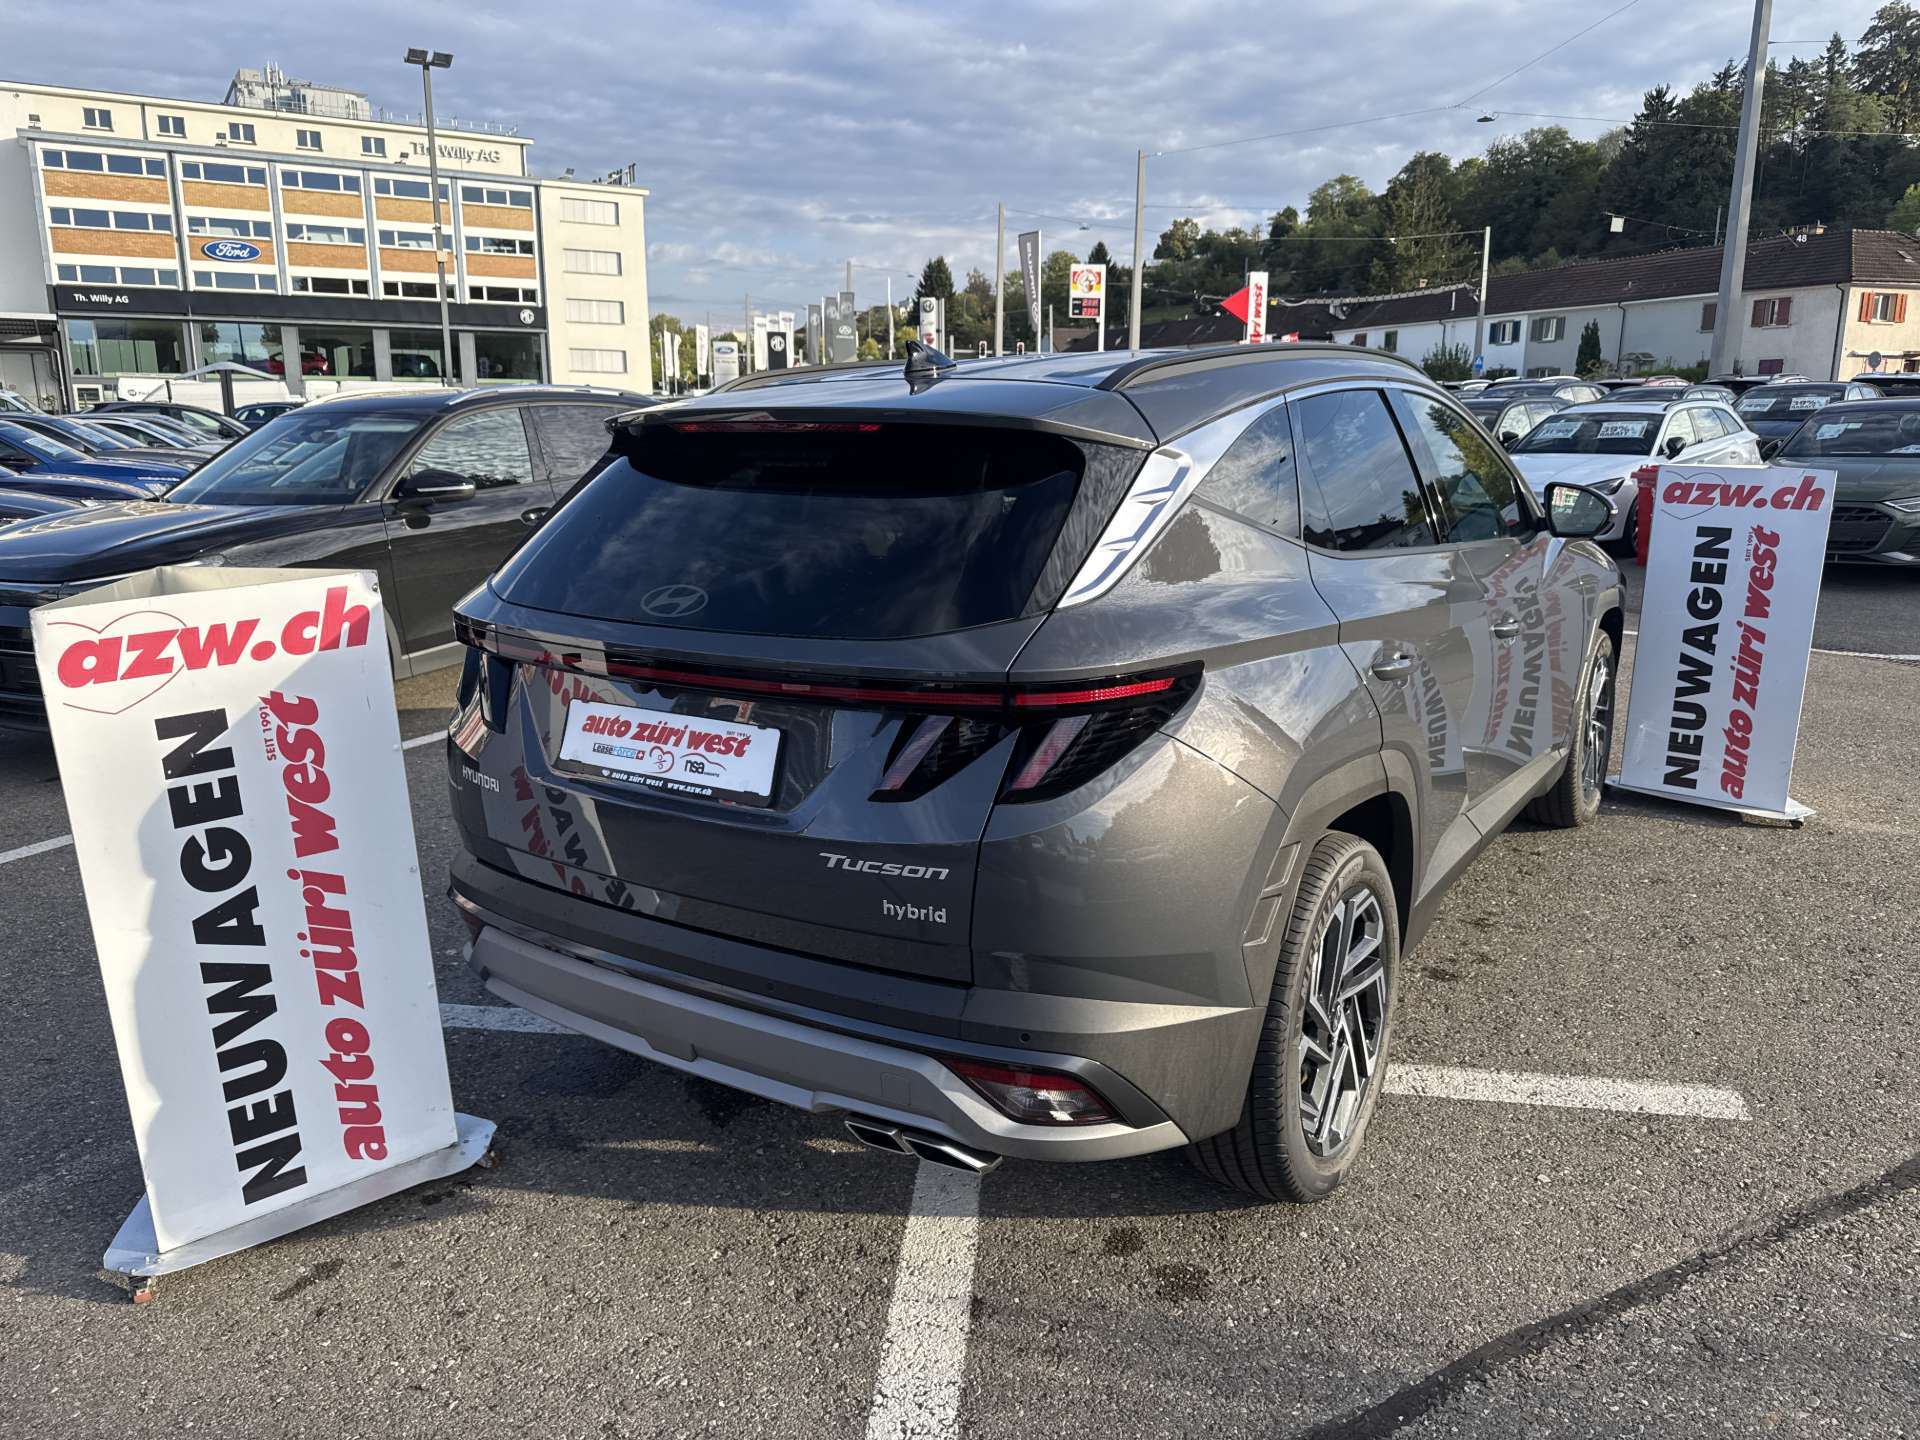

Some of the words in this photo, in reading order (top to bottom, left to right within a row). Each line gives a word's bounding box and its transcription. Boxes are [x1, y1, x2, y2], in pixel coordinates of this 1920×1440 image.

[438, 145, 473, 163] Willy
[478, 149, 501, 163] AG
[215, 242, 250, 258] Ford
[73, 293, 88, 302] Th.
[89, 294, 112, 304] Willy
[115, 295, 129, 304] AG
[1662, 475, 1826, 512] azw.ch
[1744, 525, 1780, 620] west
[57, 586, 370, 688] azw.ch
[1663, 526, 1732, 790] NEUWAGEN
[1730, 620, 1766, 711] züri
[260, 705, 274, 732] 1991
[581, 714, 632, 738] auto
[630, 721, 689, 748] züri
[688, 730, 752, 758] west
[266, 732, 279, 762] SEIT
[684, 759, 706, 774] nsa
[1720, 709, 1755, 800] auto
[259, 691, 339, 858] west
[462, 765, 500, 793] HYUNDAI
[611, 772, 627, 780] auto
[629, 775, 644, 785] züri
[646, 780, 664, 788] west
[667, 782, 712, 796] www.azw.ch
[882, 899, 947, 924] hybrid
[155, 707, 309, 1206] NEUWAGEN
[287, 868, 363, 1010] züri
[319, 1019, 387, 1162] auto
